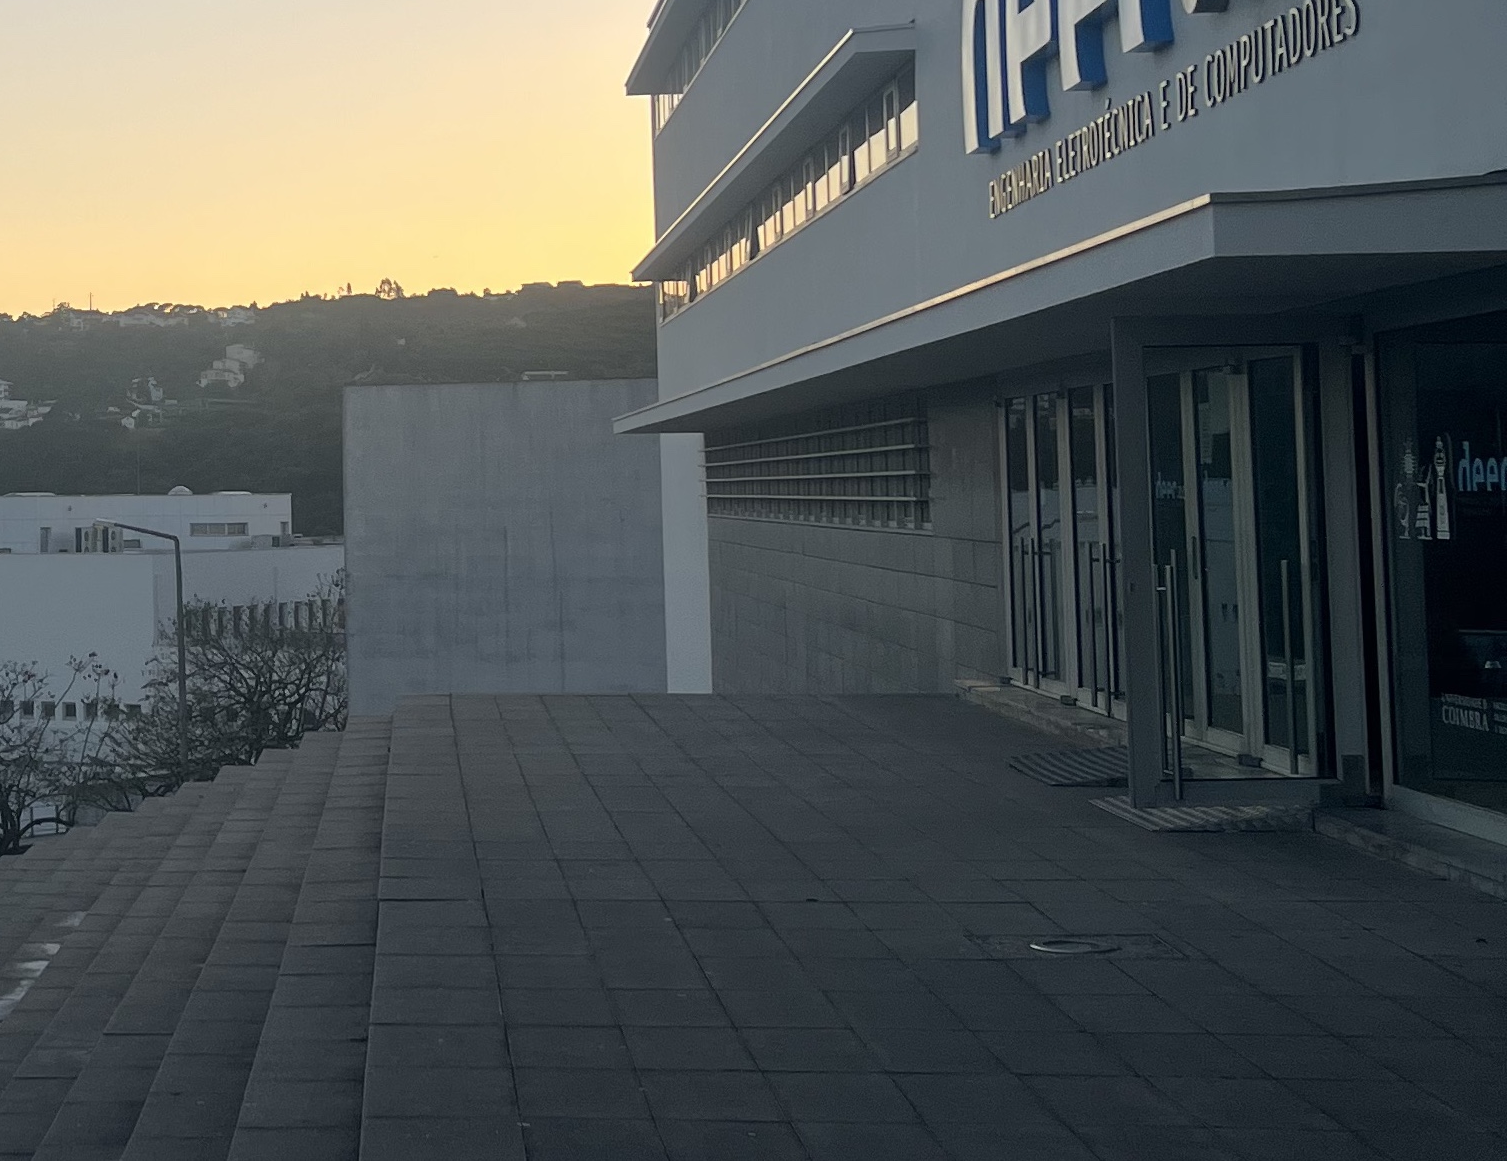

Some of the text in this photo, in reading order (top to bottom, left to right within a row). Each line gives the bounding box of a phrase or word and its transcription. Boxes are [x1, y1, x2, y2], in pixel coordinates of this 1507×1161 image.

[989, 148, 1053, 218] ENGENHARIA
[1055, 98, 1155, 183] ELETROTÉCNICA
[1159, 79, 1171, 131] E
[1176, 64, 1198, 122] DE
